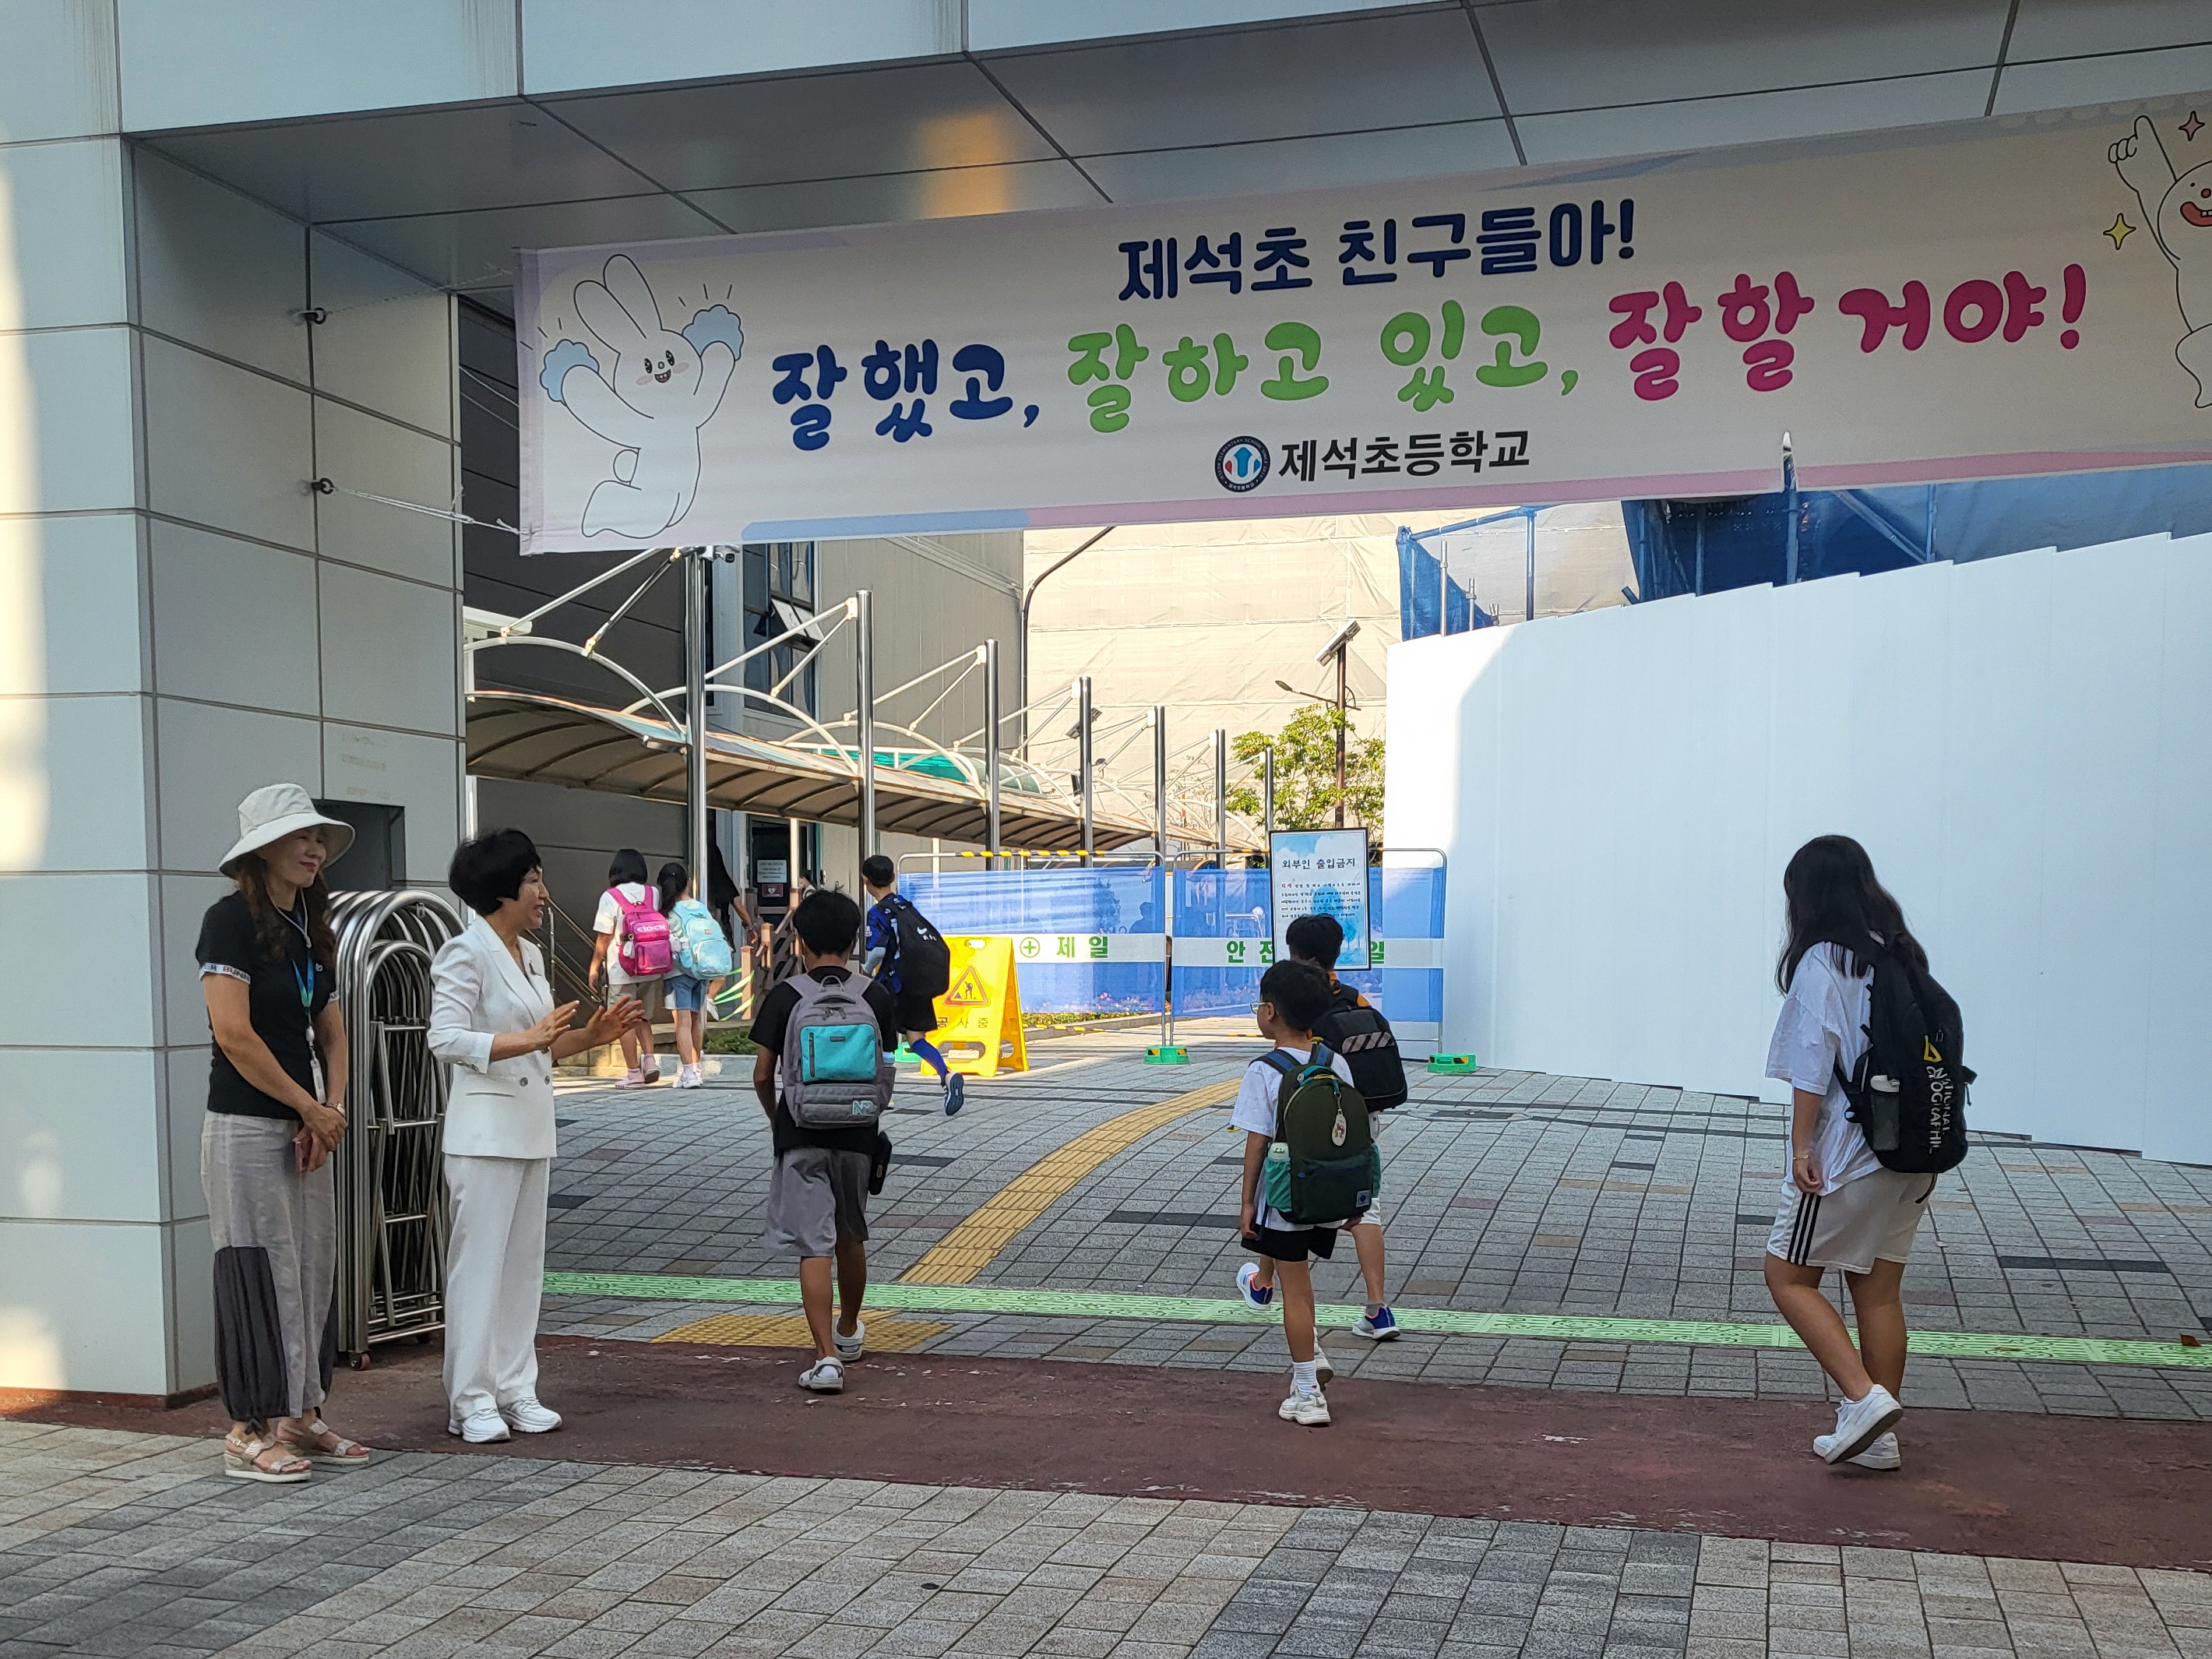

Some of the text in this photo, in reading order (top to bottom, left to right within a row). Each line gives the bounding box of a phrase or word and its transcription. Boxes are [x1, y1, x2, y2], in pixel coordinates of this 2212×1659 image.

[1118, 199, 1634, 301] 제석초 친구들아!
[772, 263, 2087, 451] 잘했고, 잘하고 있고, 잘할 거야!
[1278, 430, 1530, 482] 제석초등학교
[1281, 858, 1355, 870] 외부인 출입금지
[1925, 1066, 1944, 1154] GOGRAPHIC
